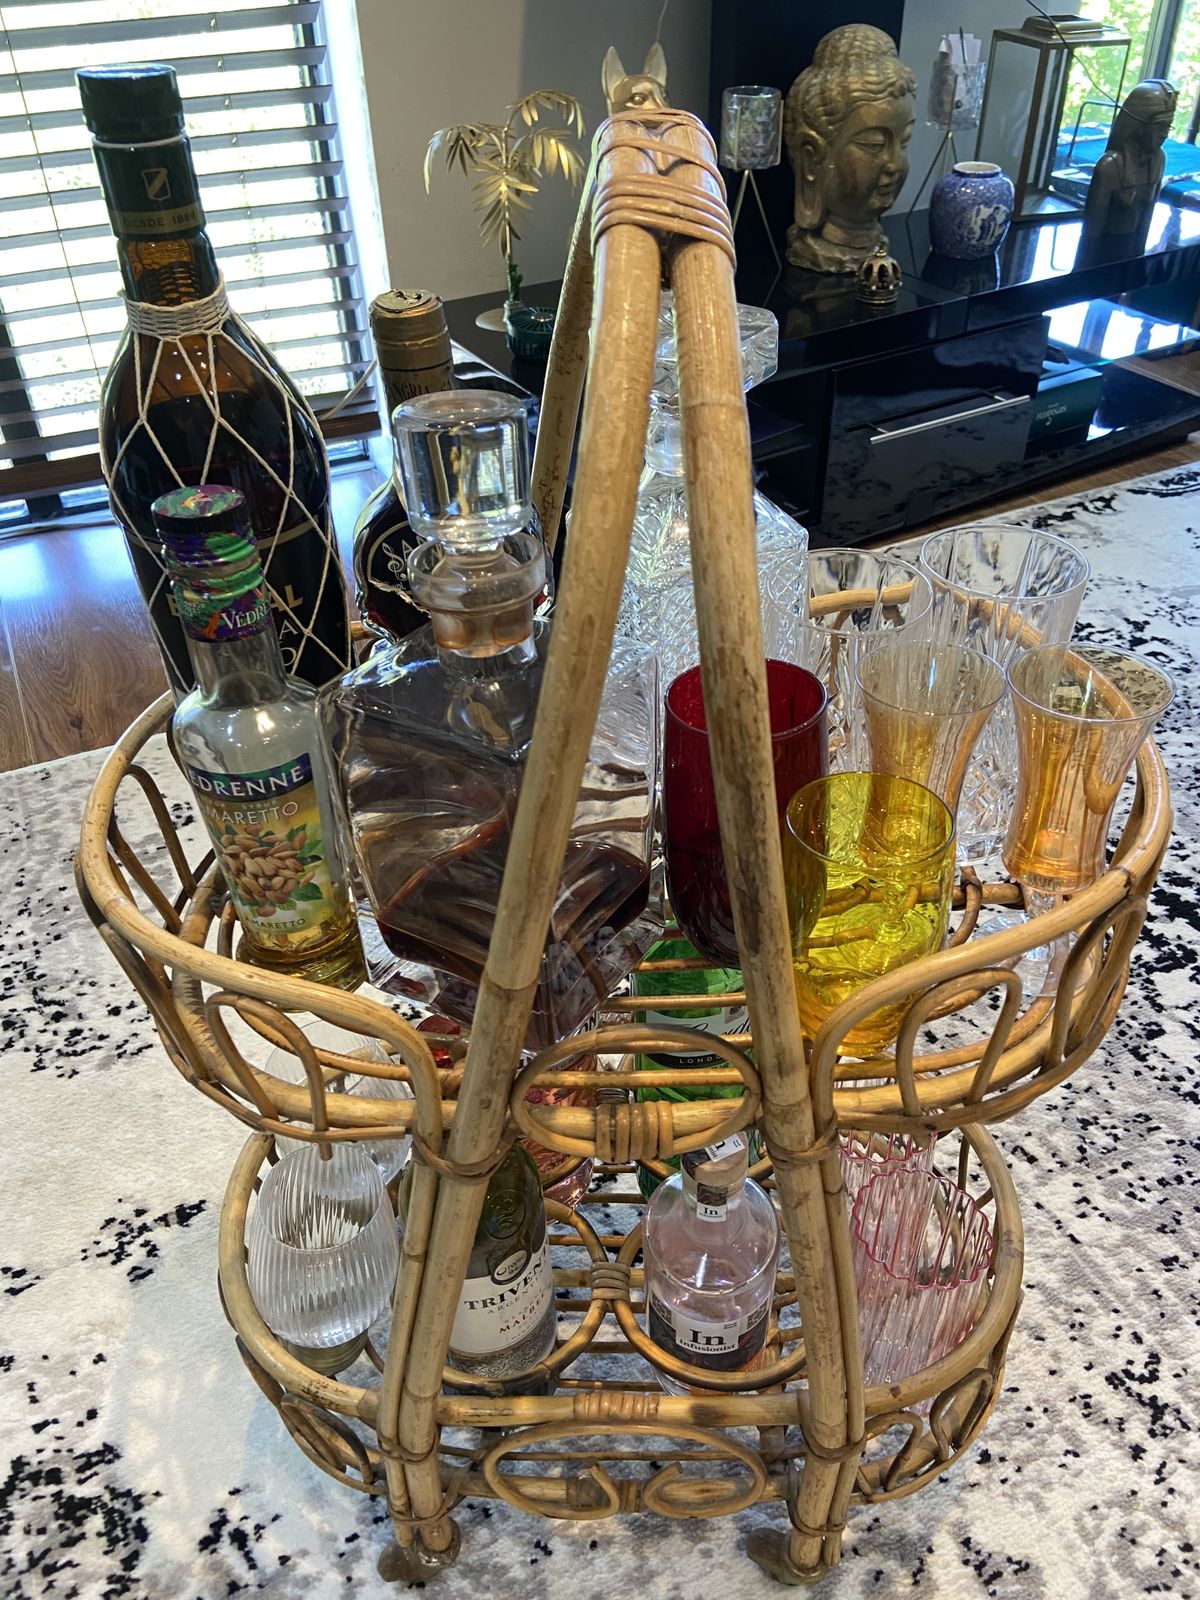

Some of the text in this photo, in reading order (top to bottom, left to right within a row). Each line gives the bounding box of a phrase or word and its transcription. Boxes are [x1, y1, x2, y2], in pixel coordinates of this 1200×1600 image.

[203, 801, 298, 825] MARETTO
[703, 1207, 719, 1216] In
[679, 1338, 736, 1352] Infusionist
[689, 1327, 727, 1347] In
